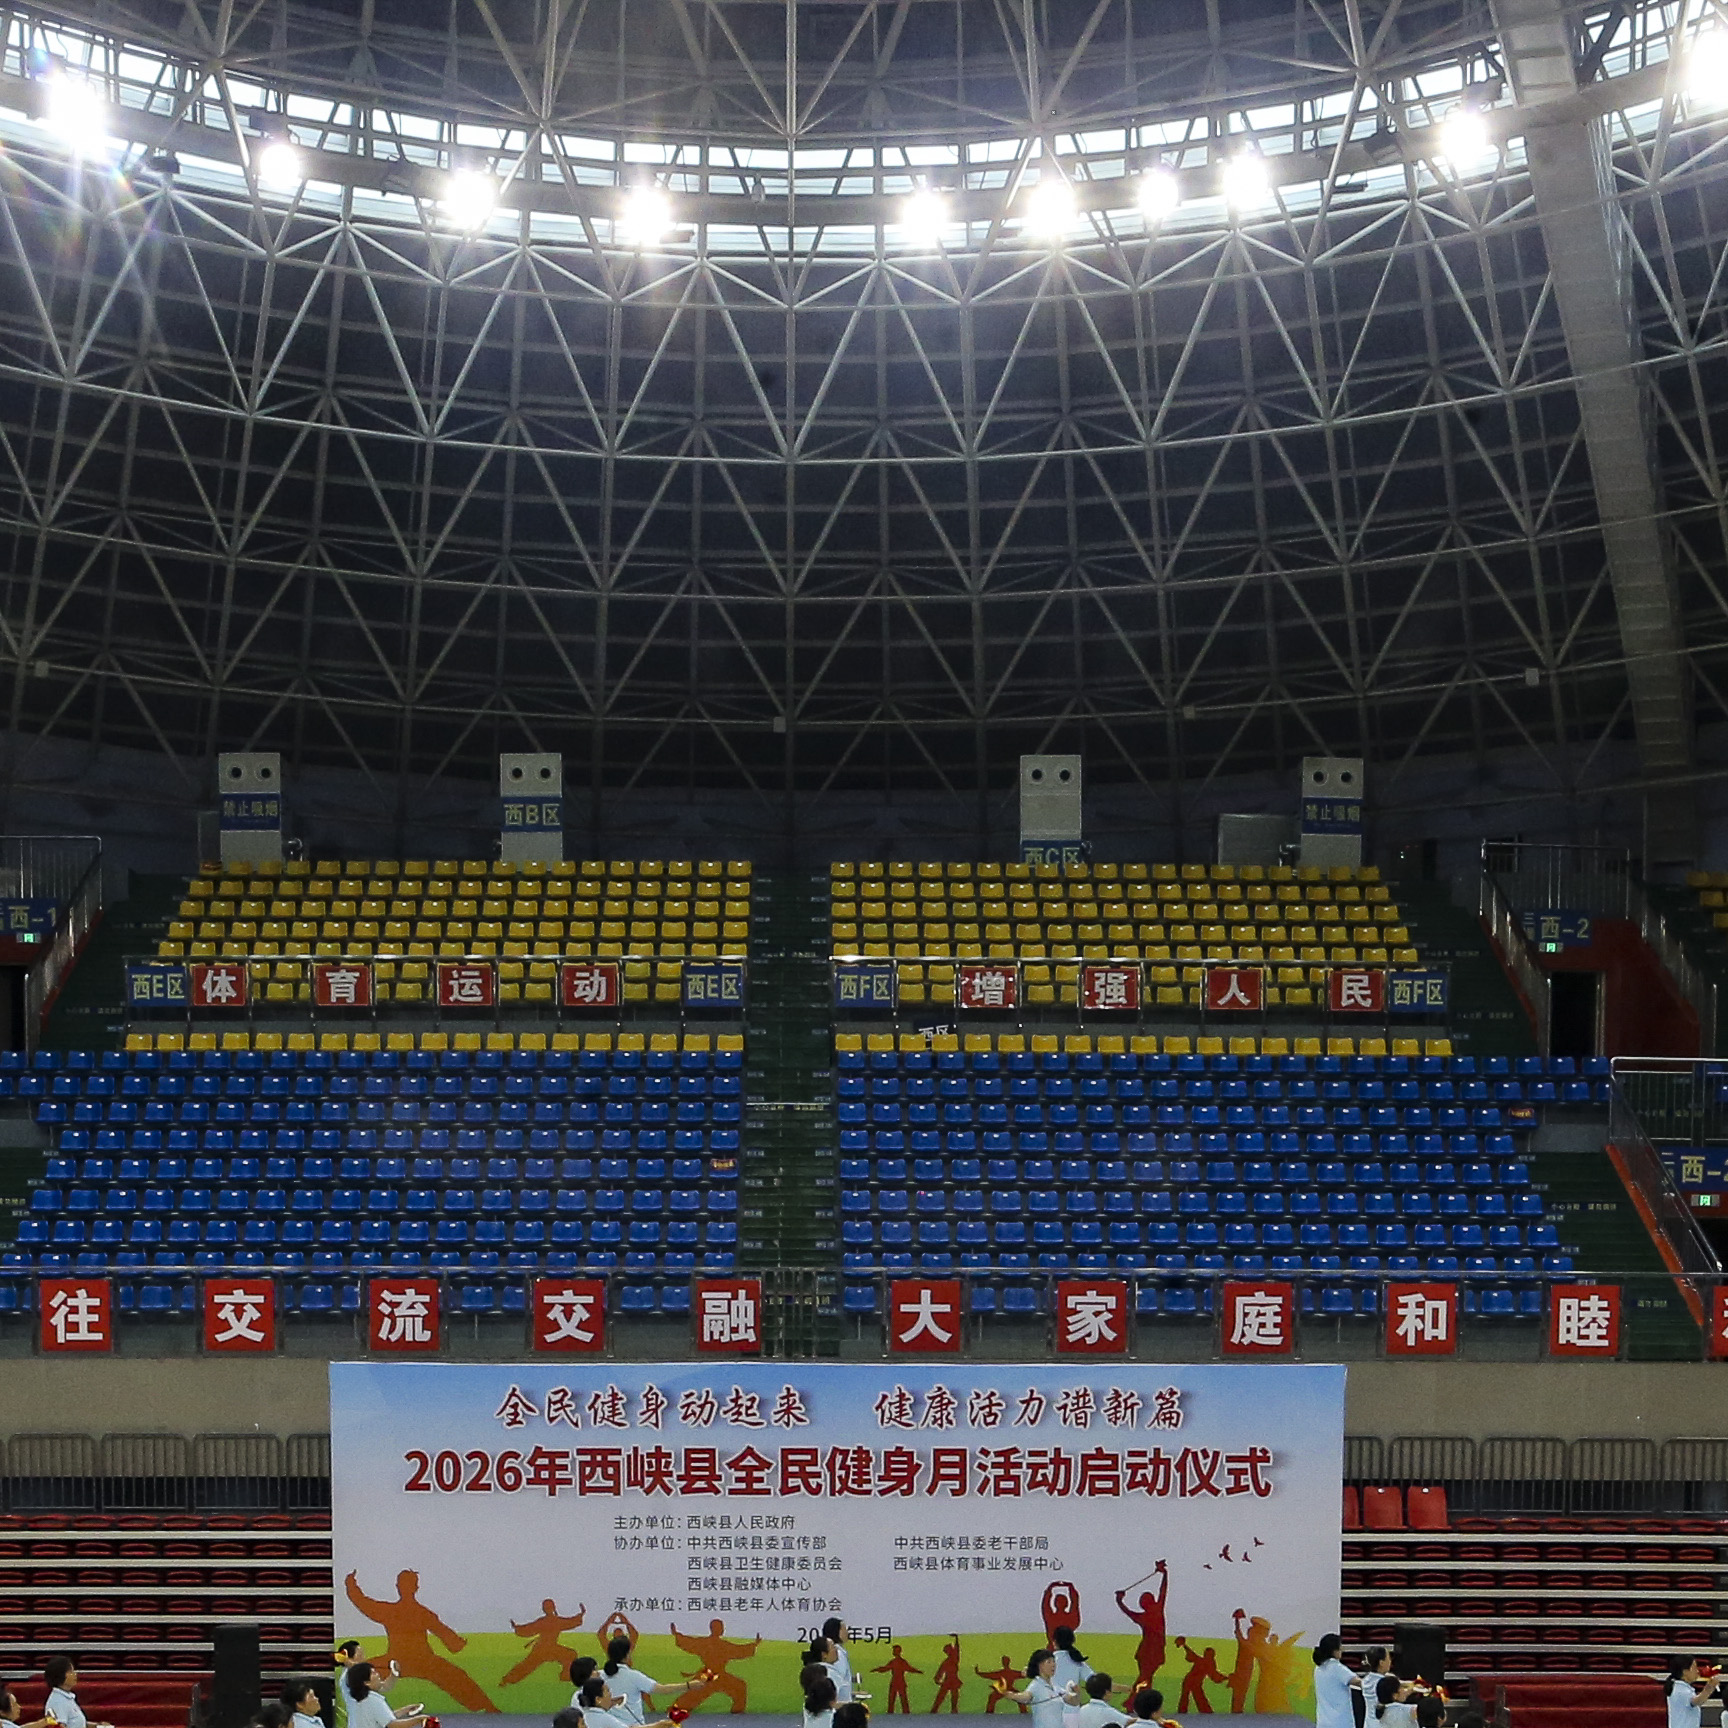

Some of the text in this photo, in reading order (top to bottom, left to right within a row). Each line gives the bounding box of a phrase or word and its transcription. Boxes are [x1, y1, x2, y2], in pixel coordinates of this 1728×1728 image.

[503, 803, 561, 826] 西B区
[132, 972, 184, 999] 西E区
[202, 969, 237, 1003] 体
[326, 969, 360, 1003] 育
[449, 969, 484, 1002] 运
[574, 969, 607, 1003] 动
[972, 971, 1006, 1004] 增
[1094, 972, 1127, 1004] 强
[1217, 974, 1251, 1006] 人
[1340, 974, 1373, 1007] 民
[687, 973, 740, 1000] 西E区
[839, 974, 891, 1000] 西F区
[1393, 979, 1443, 1005] 西F区
[49, 1289, 103, 1343] 往
[213, 1289, 265, 1342] 交
[378, 1289, 432, 1342] 流
[543, 1289, 595, 1342] 交
[702, 1290, 756, 1343] 融
[899, 1290, 952, 1343] 大
[1065, 1291, 1118, 1344] 家
[1231, 1291, 1284, 1345] 庭
[1395, 1293, 1447, 1346] 和
[1559, 1295, 1611, 1347] 睦
[494, 1383, 1187, 1430] 全民健身动起来 健康活力谱新篇
[405, 1446, 1272, 1498] 2026年西峡县全民健身月活动启动仪式
[614, 1515, 796, 1530] 主办单位：西峡县人民政府
[614, 1535, 1049, 1551] 协办单位：中共西峡县委宣传部 中共西峡县委老干部局
[687, 1556, 1064, 1572] 西峡县卫生健康委员会 西峡县体育事业发展中心
[687, 1577, 812, 1592] 西峡县融媒体中心
[614, 1597, 842, 1612] 承办单位：西峡县老年人体育协会
[797, 1627, 893, 1646] 20年5月
